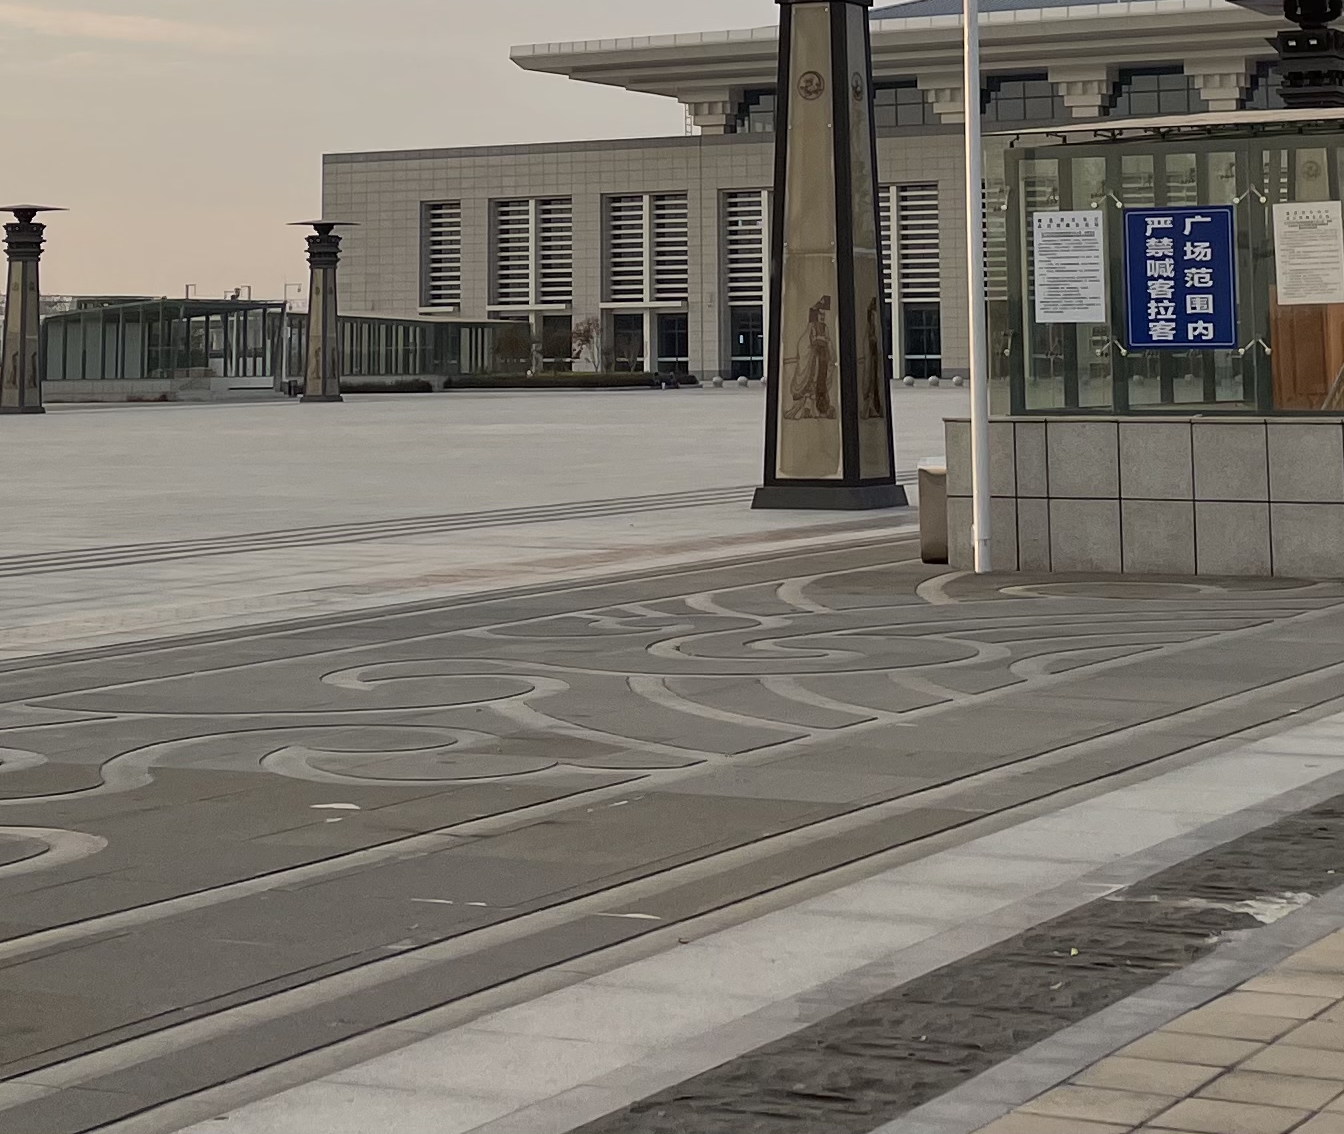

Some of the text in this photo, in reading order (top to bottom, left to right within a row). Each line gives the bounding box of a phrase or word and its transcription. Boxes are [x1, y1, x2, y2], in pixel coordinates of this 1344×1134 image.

[1145, 216, 1176, 340] 严禁喊客拉客
[1183, 215, 1214, 340] 广场范围内
